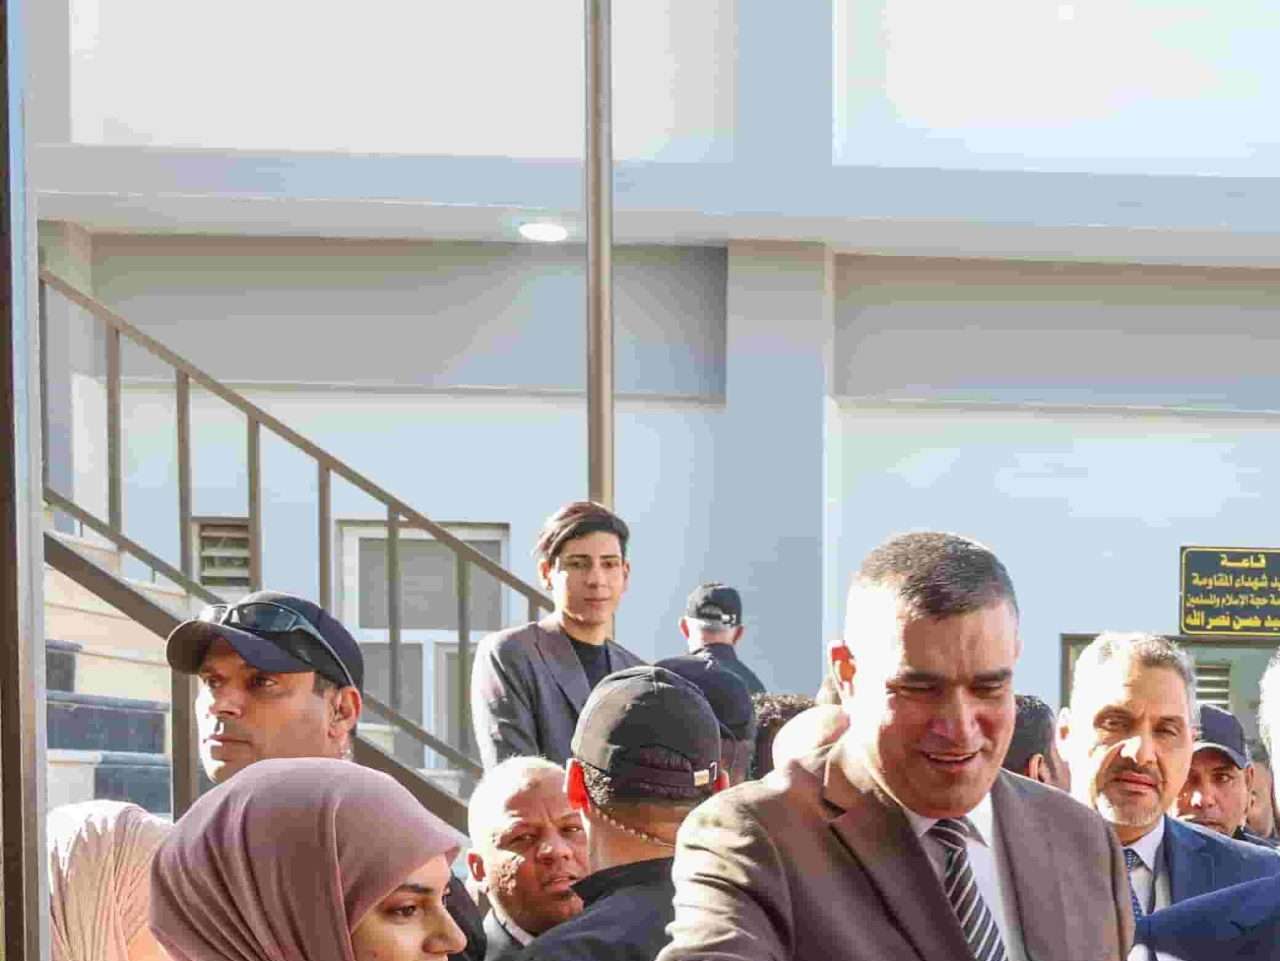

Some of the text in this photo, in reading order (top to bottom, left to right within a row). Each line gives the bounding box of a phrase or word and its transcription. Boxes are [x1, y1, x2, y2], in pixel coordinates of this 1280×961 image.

[1220, 553, 1266, 568] قاعة
[1191, 572, 1233, 589] المقاومة
[1235, 573, 1268, 591] شهداء
[1185, 610, 1205, 626] الله
[1205, 611, 1231, 629] نصر
[1233, 615, 1262, 630] حسن
